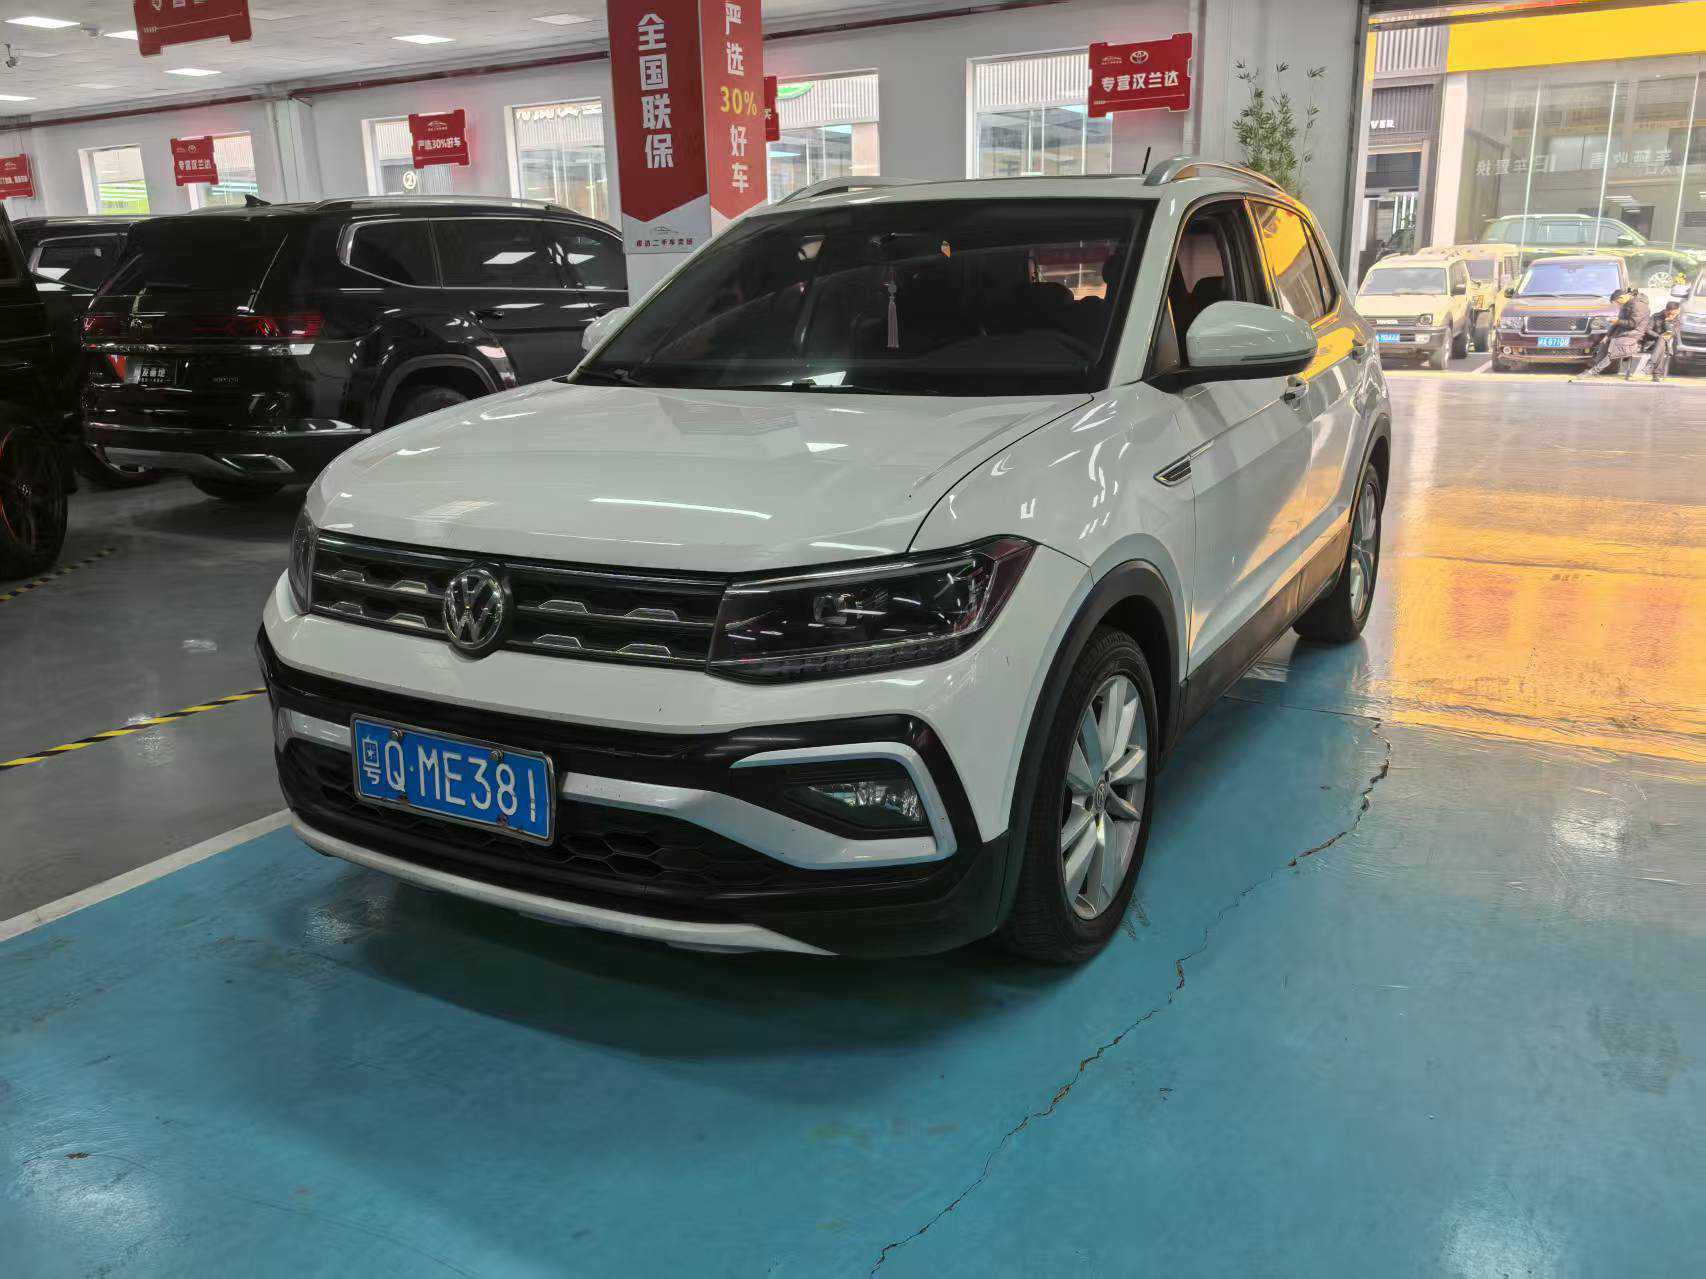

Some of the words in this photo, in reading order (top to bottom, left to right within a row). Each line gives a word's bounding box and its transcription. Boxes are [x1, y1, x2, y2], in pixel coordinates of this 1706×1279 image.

[636, 13, 674, 169] 全国联保
[720, 3, 757, 193] 严选30%好车
[1102, 71, 1179, 92] 专营汉兰达
